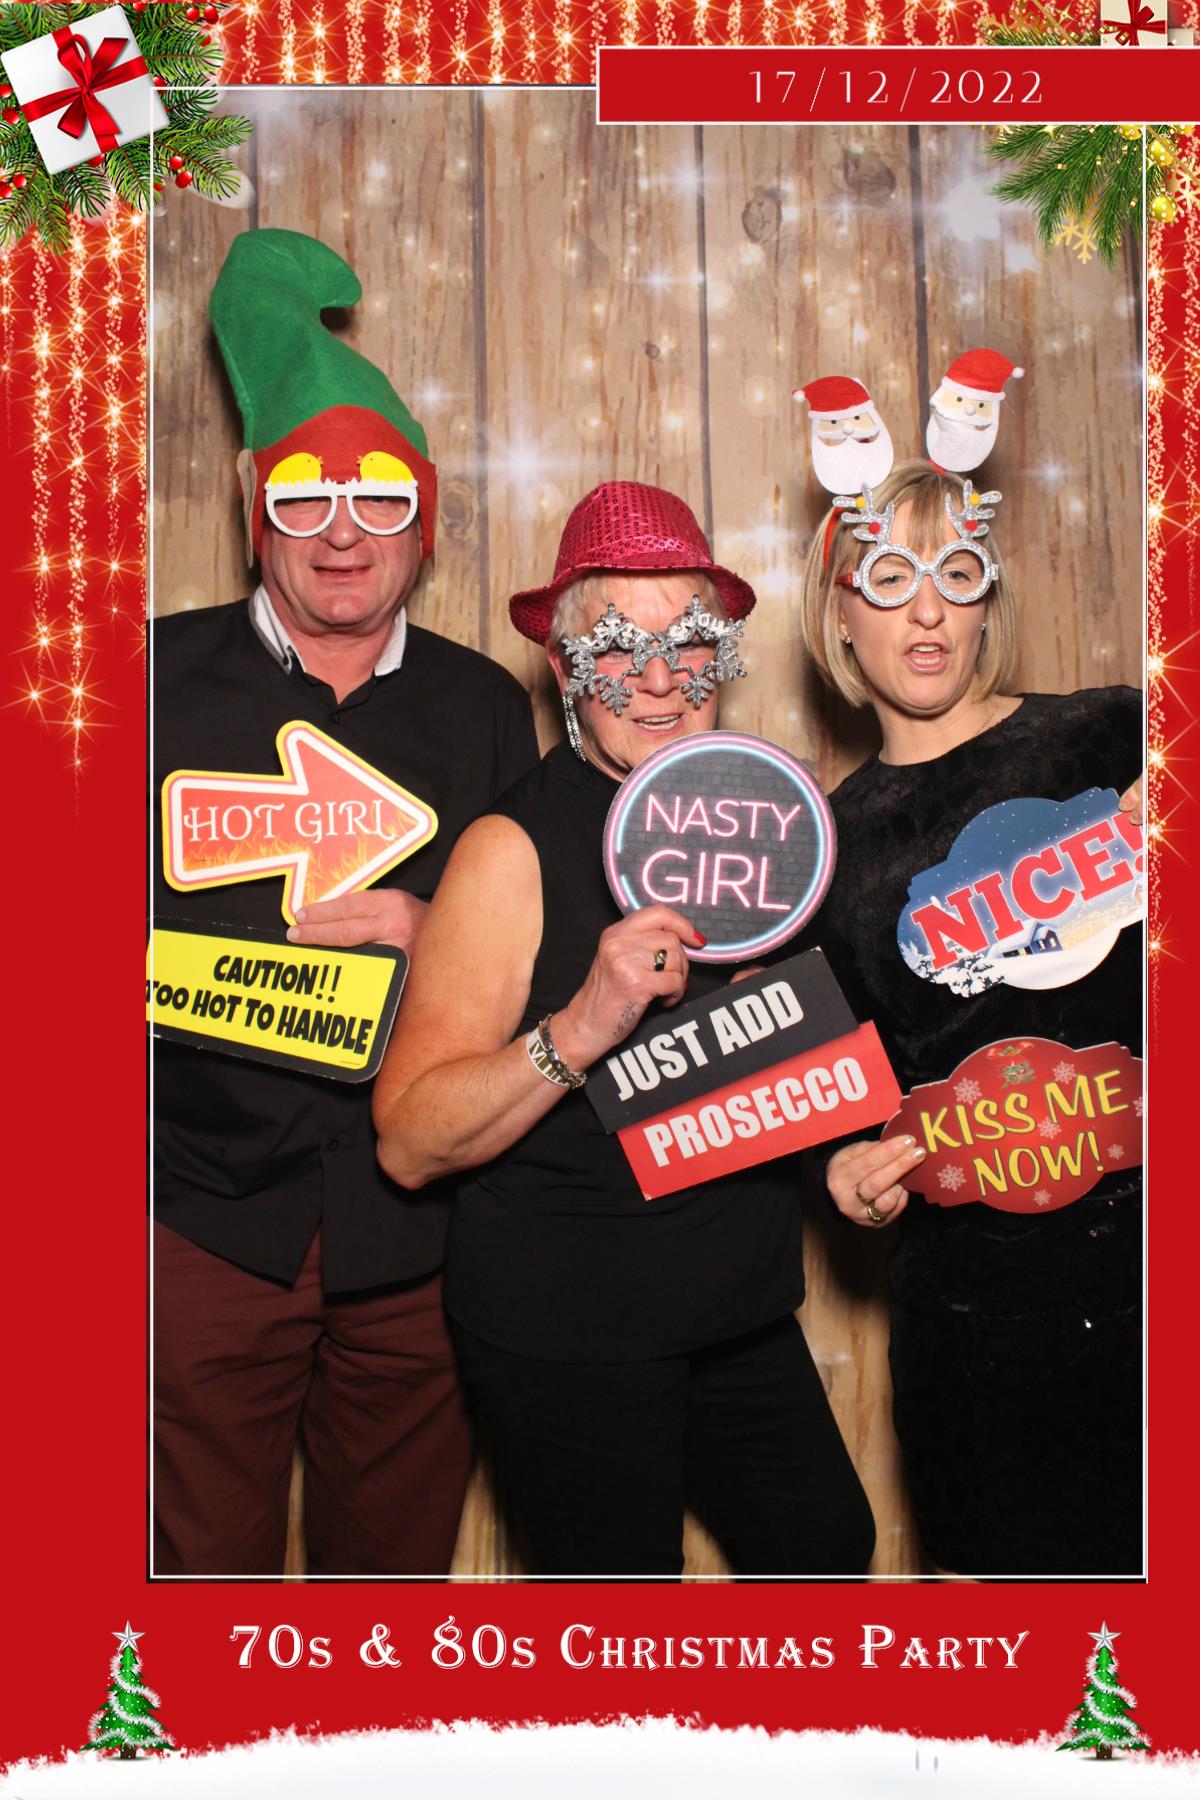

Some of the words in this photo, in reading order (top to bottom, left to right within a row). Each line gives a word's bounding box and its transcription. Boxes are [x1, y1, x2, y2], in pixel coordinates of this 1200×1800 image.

[184, 803, 285, 842] HOT
[294, 800, 397, 844] GIRL
[644, 794, 801, 841] NASTY
[641, 849, 793, 912] GIRL
[911, 812, 1142, 969] NICE!
[213, 955, 342, 1003] CAUTION!!
[146, 979, 189, 1010] TOO
[191, 989, 242, 1023] HOT
[244, 1001, 275, 1031] TO
[276, 1005, 374, 1055] HANDLE
[606, 1020, 710, 1101] JUST
[711, 981, 805, 1056] ADD
[643, 1057, 869, 1168] PROSECCO
[919, 1092, 1037, 1154] KISS
[1043, 1070, 1129, 1124] ME
[973, 1131, 1105, 1196] NOW!
